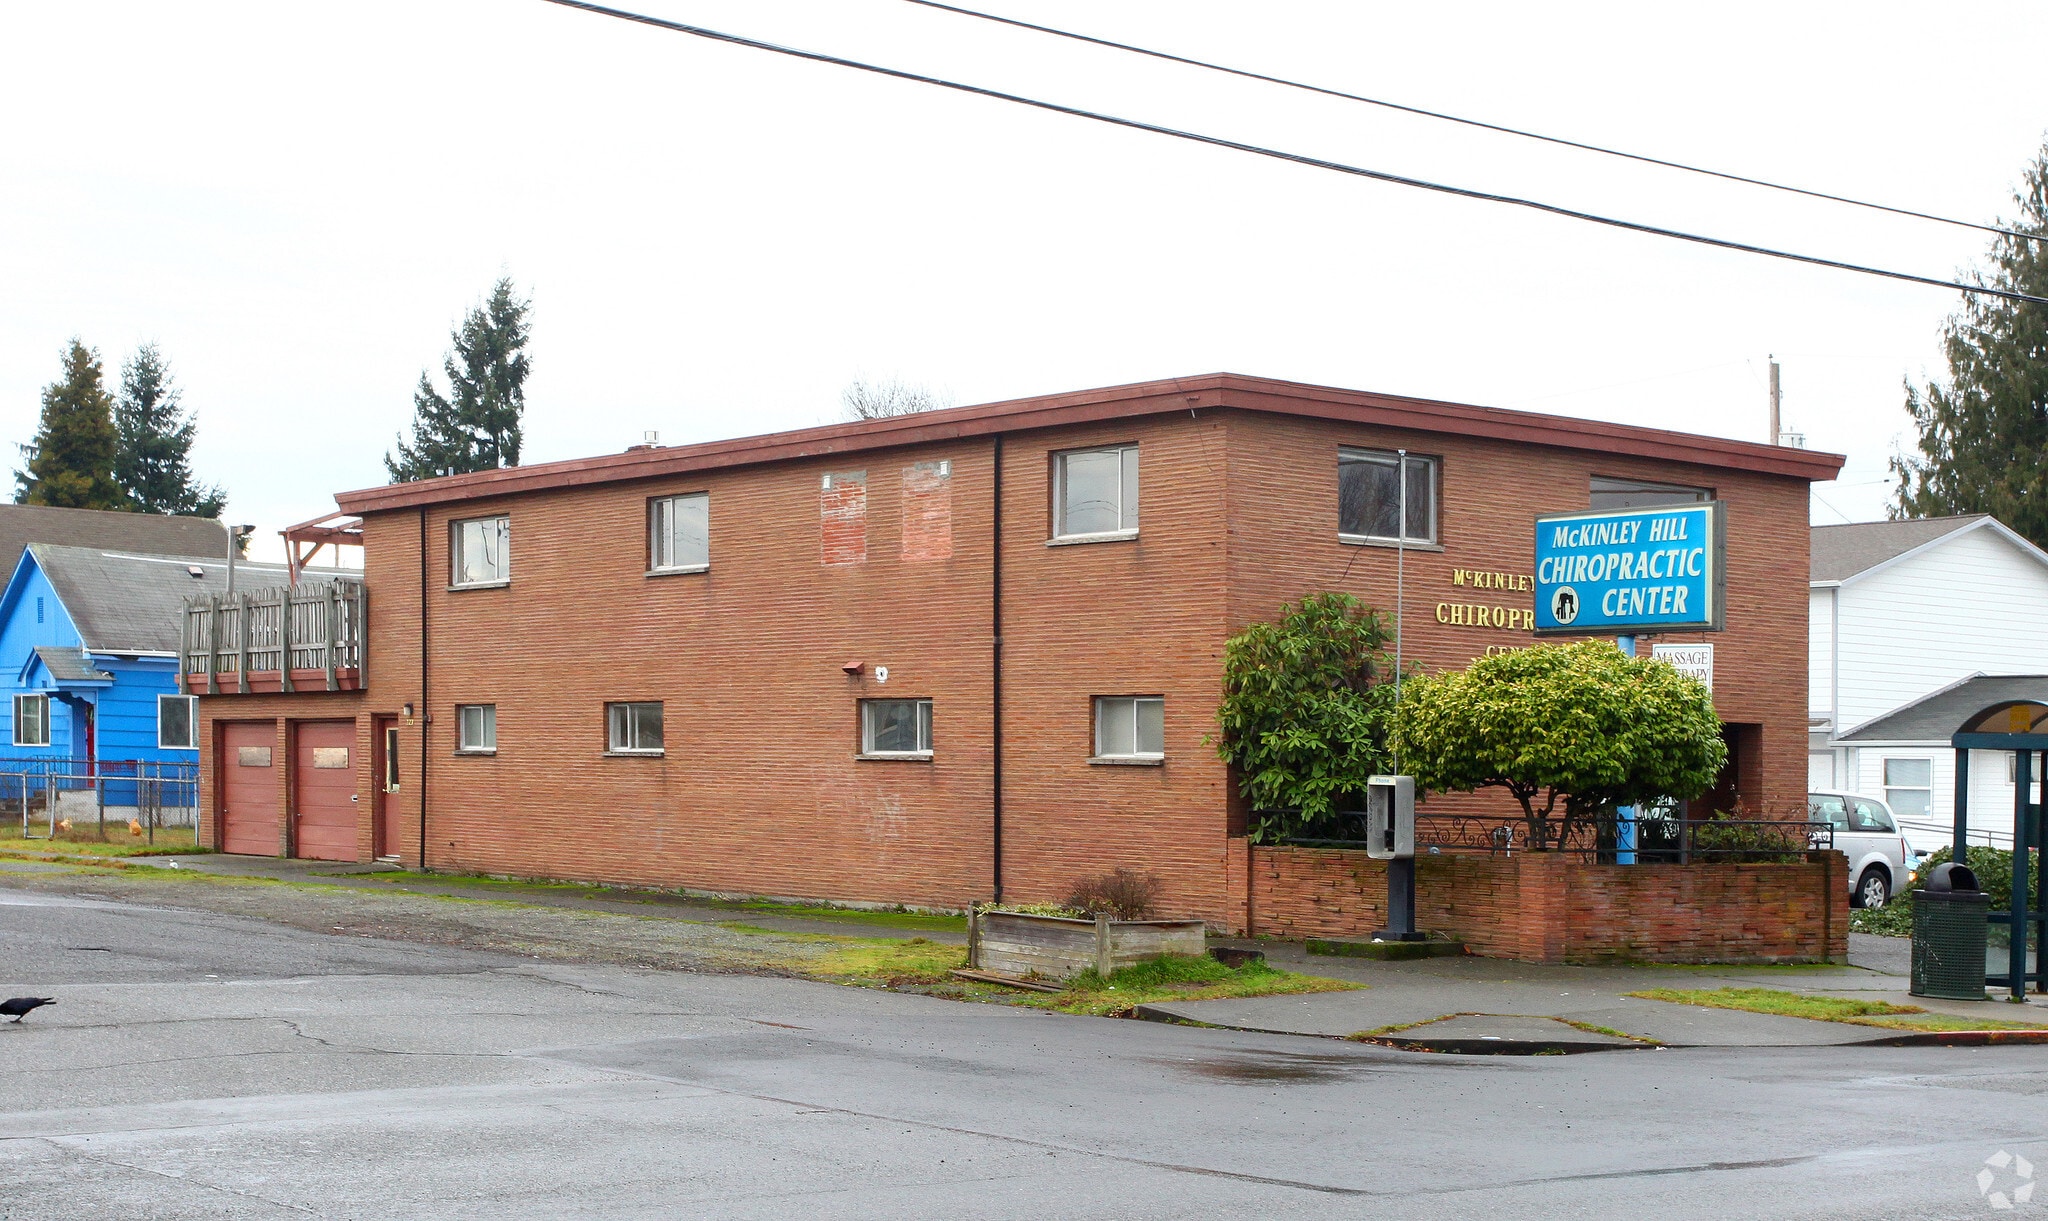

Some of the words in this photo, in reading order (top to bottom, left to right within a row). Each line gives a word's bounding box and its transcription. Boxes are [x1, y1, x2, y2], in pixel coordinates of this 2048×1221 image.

[1552, 520, 1642, 548] McKINLEY
[1649, 517, 1687, 542] HILL
[1538, 547, 1703, 585] CHIROPRACTIC
[1436, 602, 1534, 631] CHIROPR
[1602, 585, 1689, 617] CENTER
[1657, 651, 1708, 665] MASSAGE
